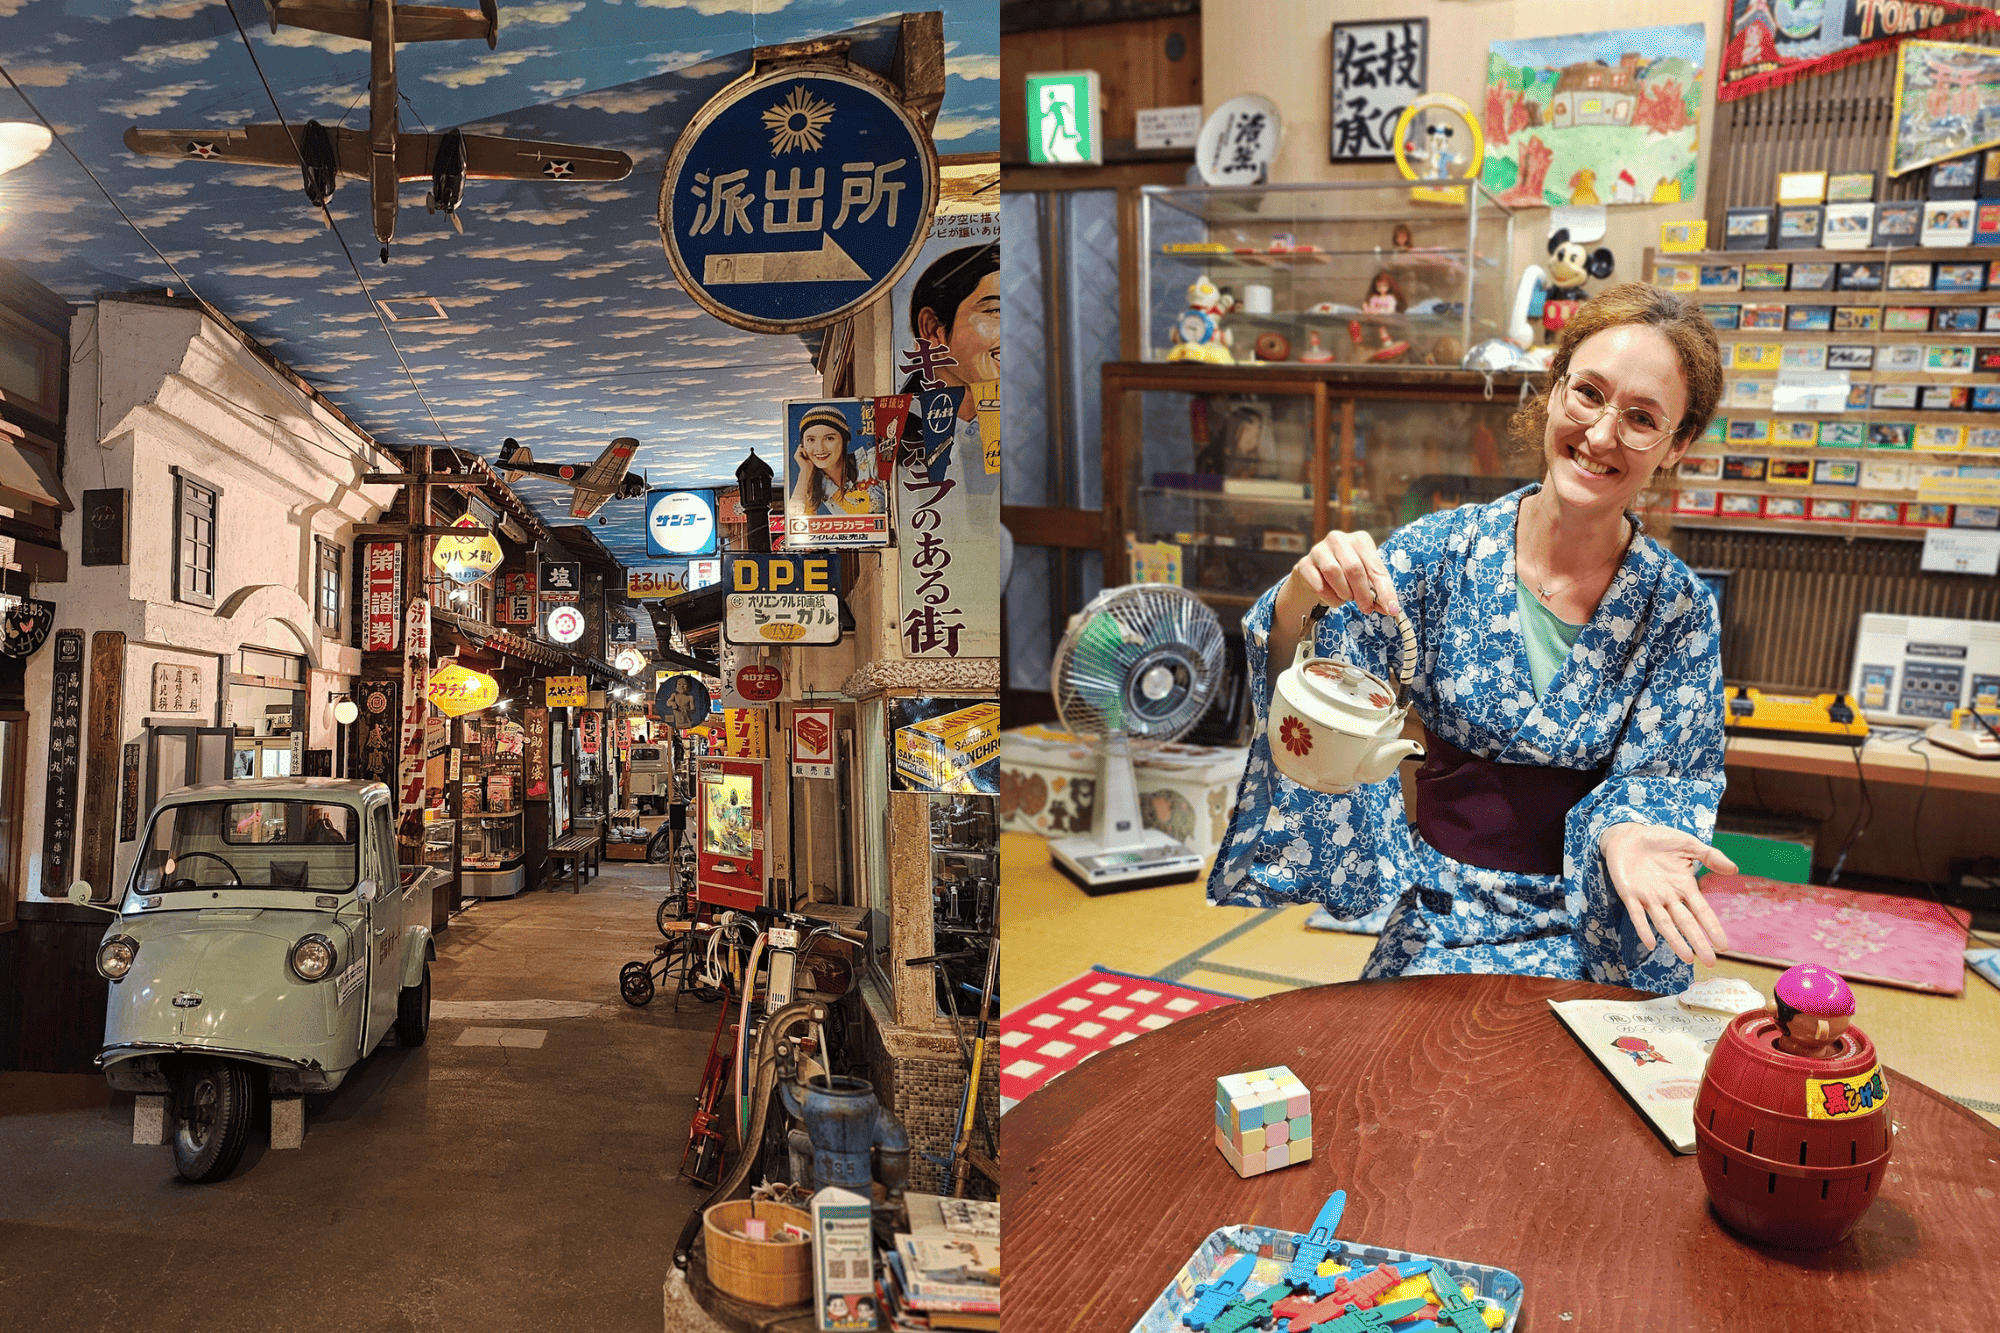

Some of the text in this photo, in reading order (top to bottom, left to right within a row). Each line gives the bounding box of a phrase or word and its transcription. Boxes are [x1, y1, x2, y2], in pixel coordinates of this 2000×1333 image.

[1856, 0, 1945, 39] TOKYO
[689, 158, 906, 237] 派出所
[656, 513, 706, 527] サンヨー
[548, 566, 573, 588] 塩
[629, 572, 680, 591] まるいし
[371, 549, 393, 644] 第一證券
[513, 597, 528, 620] 仁丹
[754, 608, 837, 625] シーガル
[742, 673, 779, 681] オロナミン
[756, 681, 765, 689] C
[530, 718, 544, 780] 福助足袋
[954, 729, 992, 751] SAKURA
[796, 765, 831, 776] 販売店
[174, 998, 200, 1006] Midget
[1605, 1012, 1719, 1025] 飛騨高山
